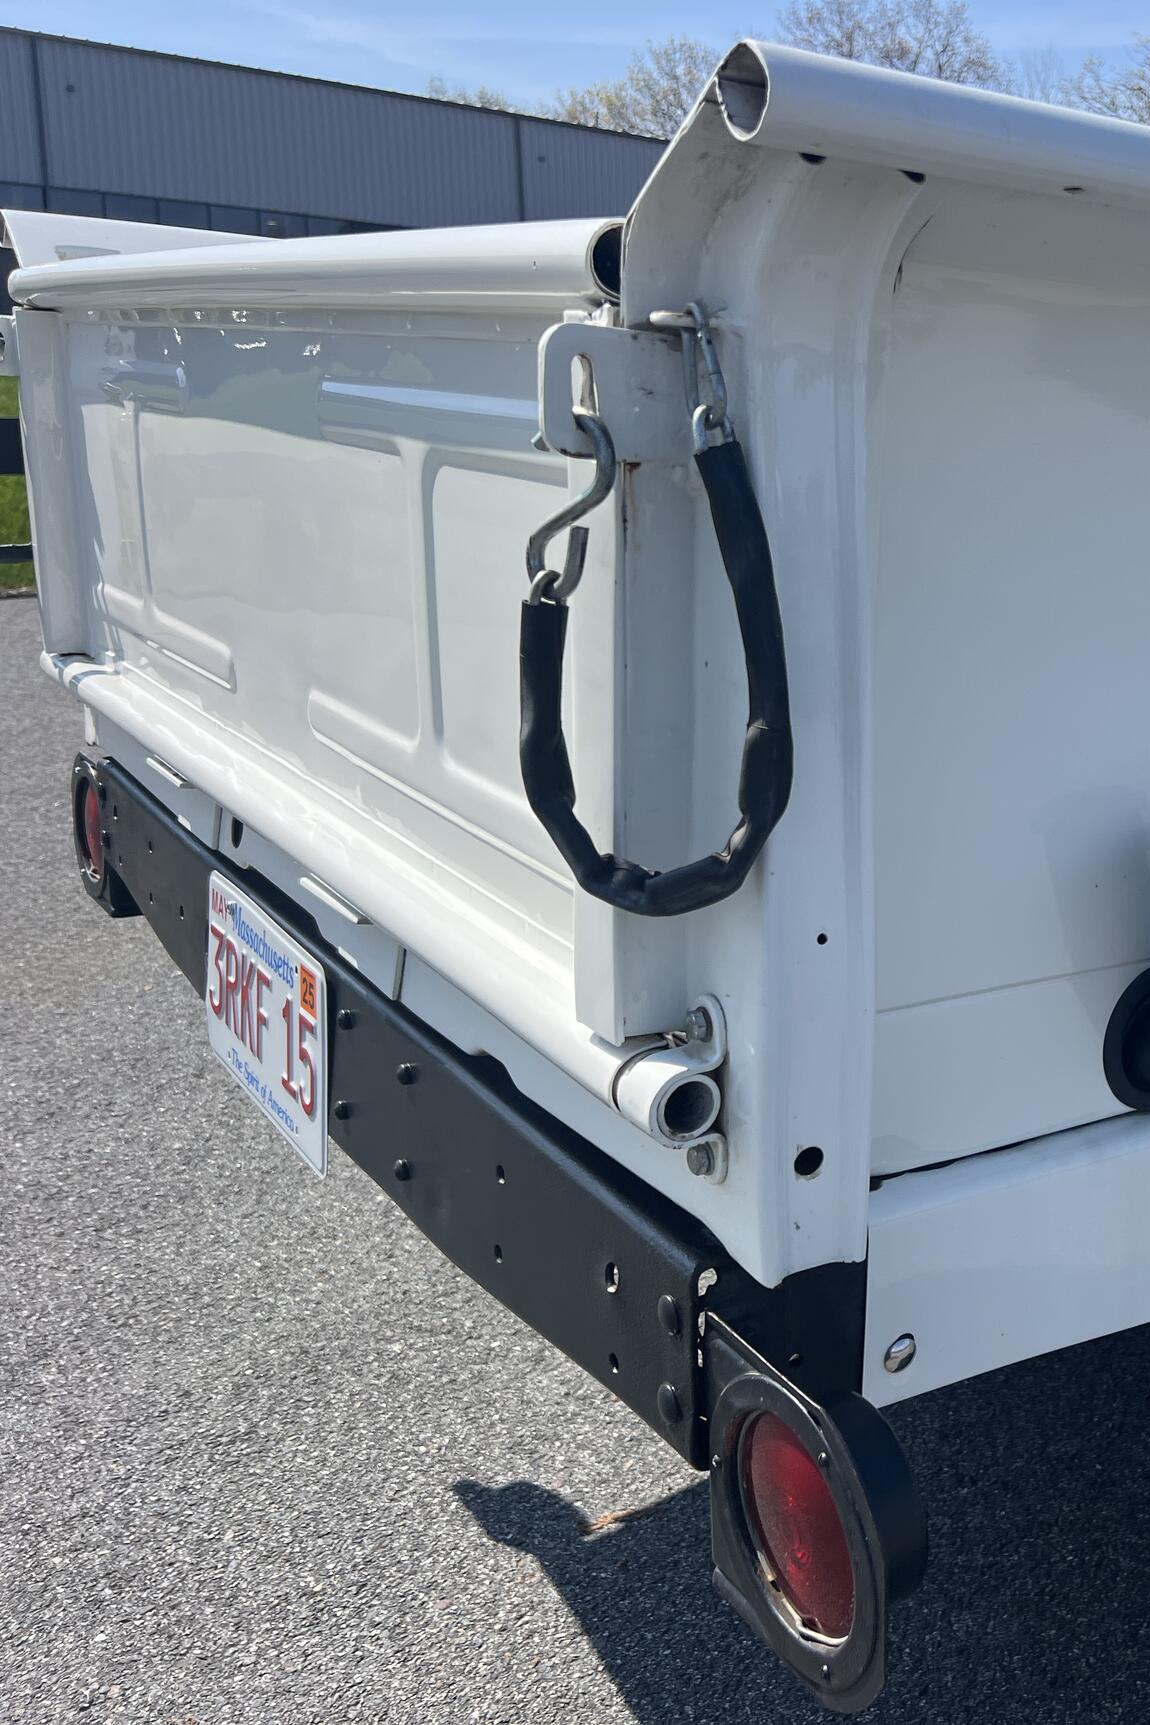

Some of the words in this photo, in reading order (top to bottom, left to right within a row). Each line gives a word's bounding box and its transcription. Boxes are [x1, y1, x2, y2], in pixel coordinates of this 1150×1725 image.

[211, 887, 229, 922] MAY
[231, 902, 294, 989] Massachusetts
[209, 923, 271, 1063] 3RKF
[281, 996, 316, 1117] 15
[302, 976, 315, 1011] 25
[231, 1047, 243, 1074] The
[243, 1061, 260, 1093] Spirit
[260, 1085, 268, 1104] of
[267, 1089, 295, 1132] America
